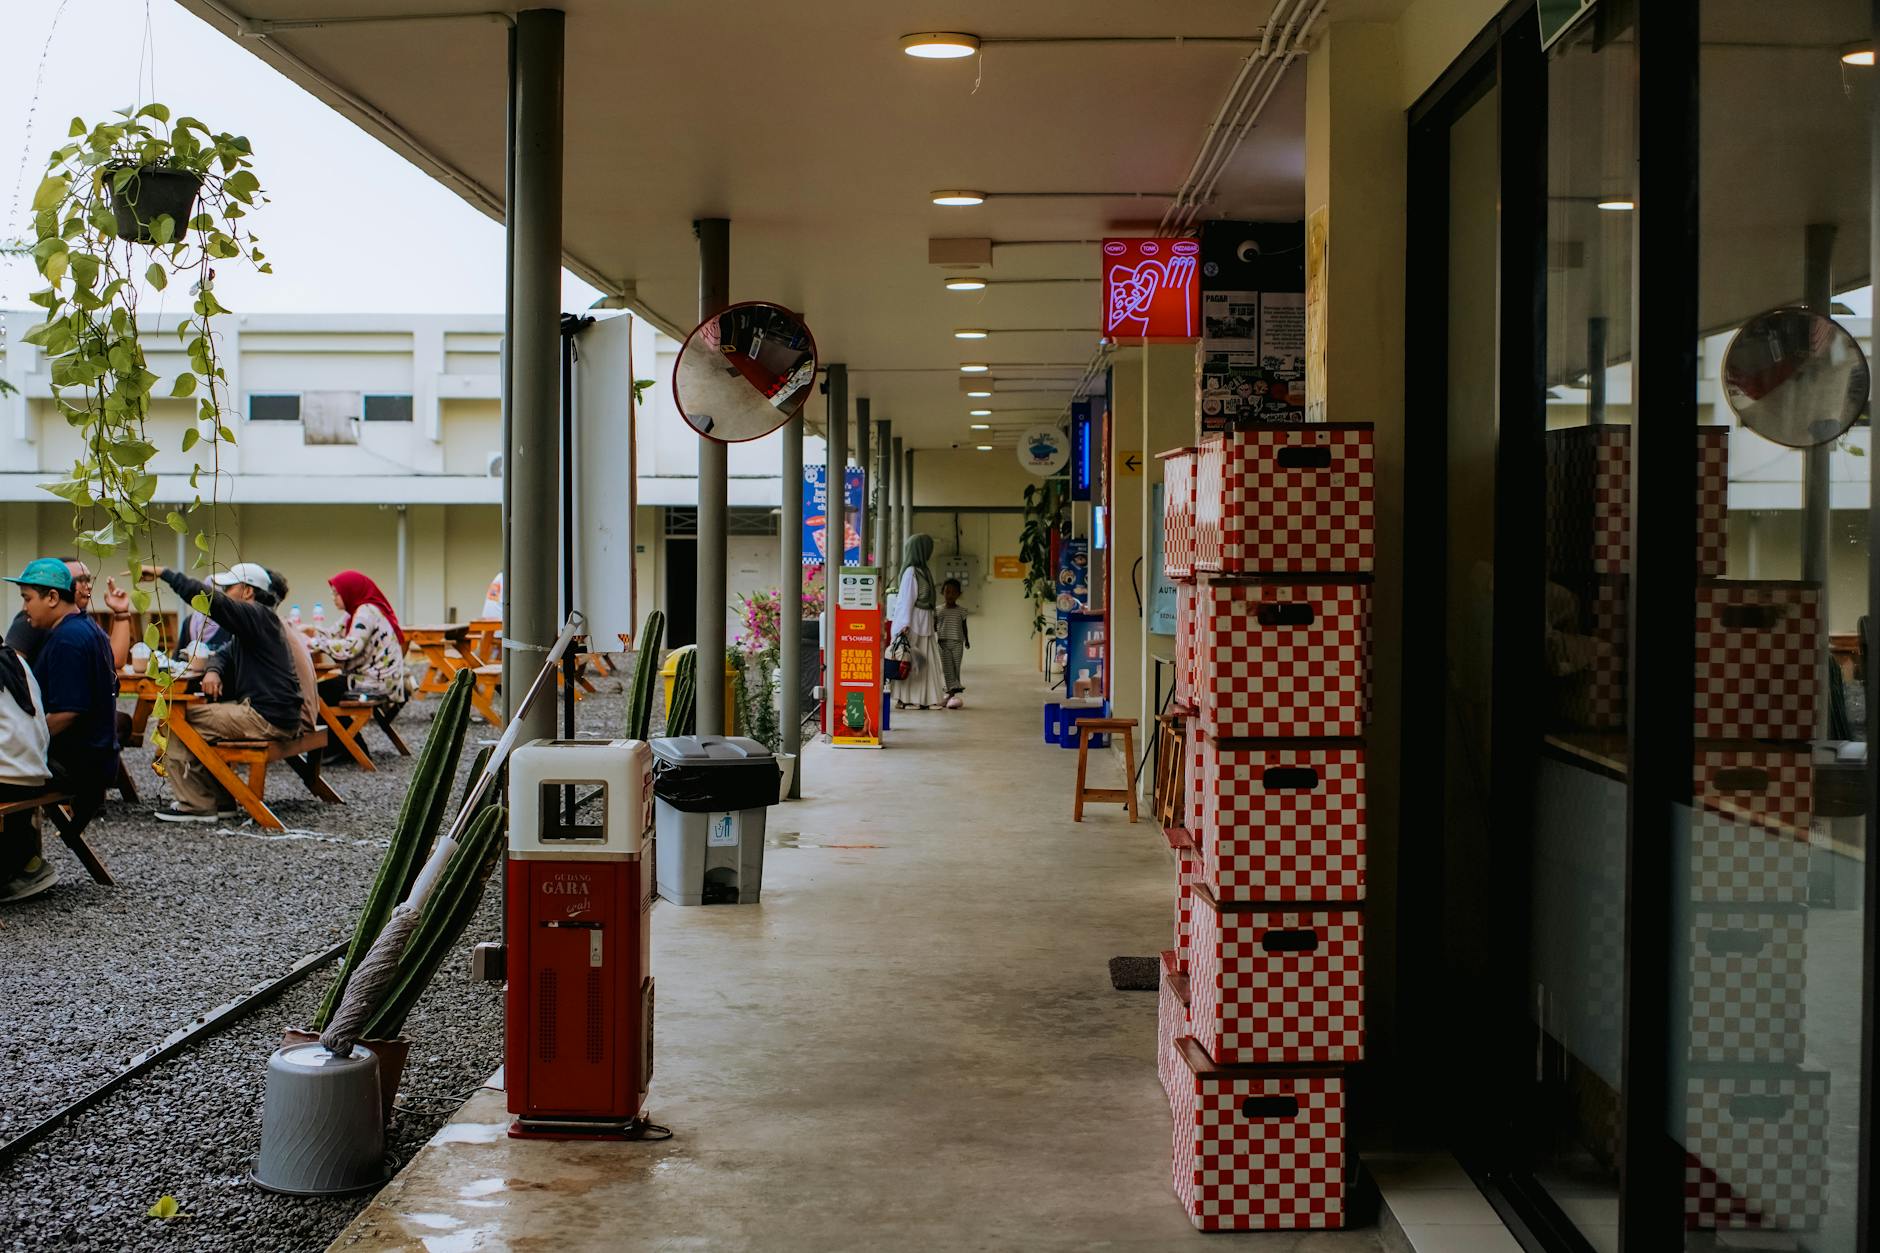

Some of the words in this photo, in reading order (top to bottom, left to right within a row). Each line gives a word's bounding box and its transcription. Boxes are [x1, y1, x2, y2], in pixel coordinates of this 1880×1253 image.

[841, 649, 872, 657] SEWA
[841, 663, 872, 671] BANK
[841, 671, 851, 680] DI
[853, 671, 872, 680] SINI
